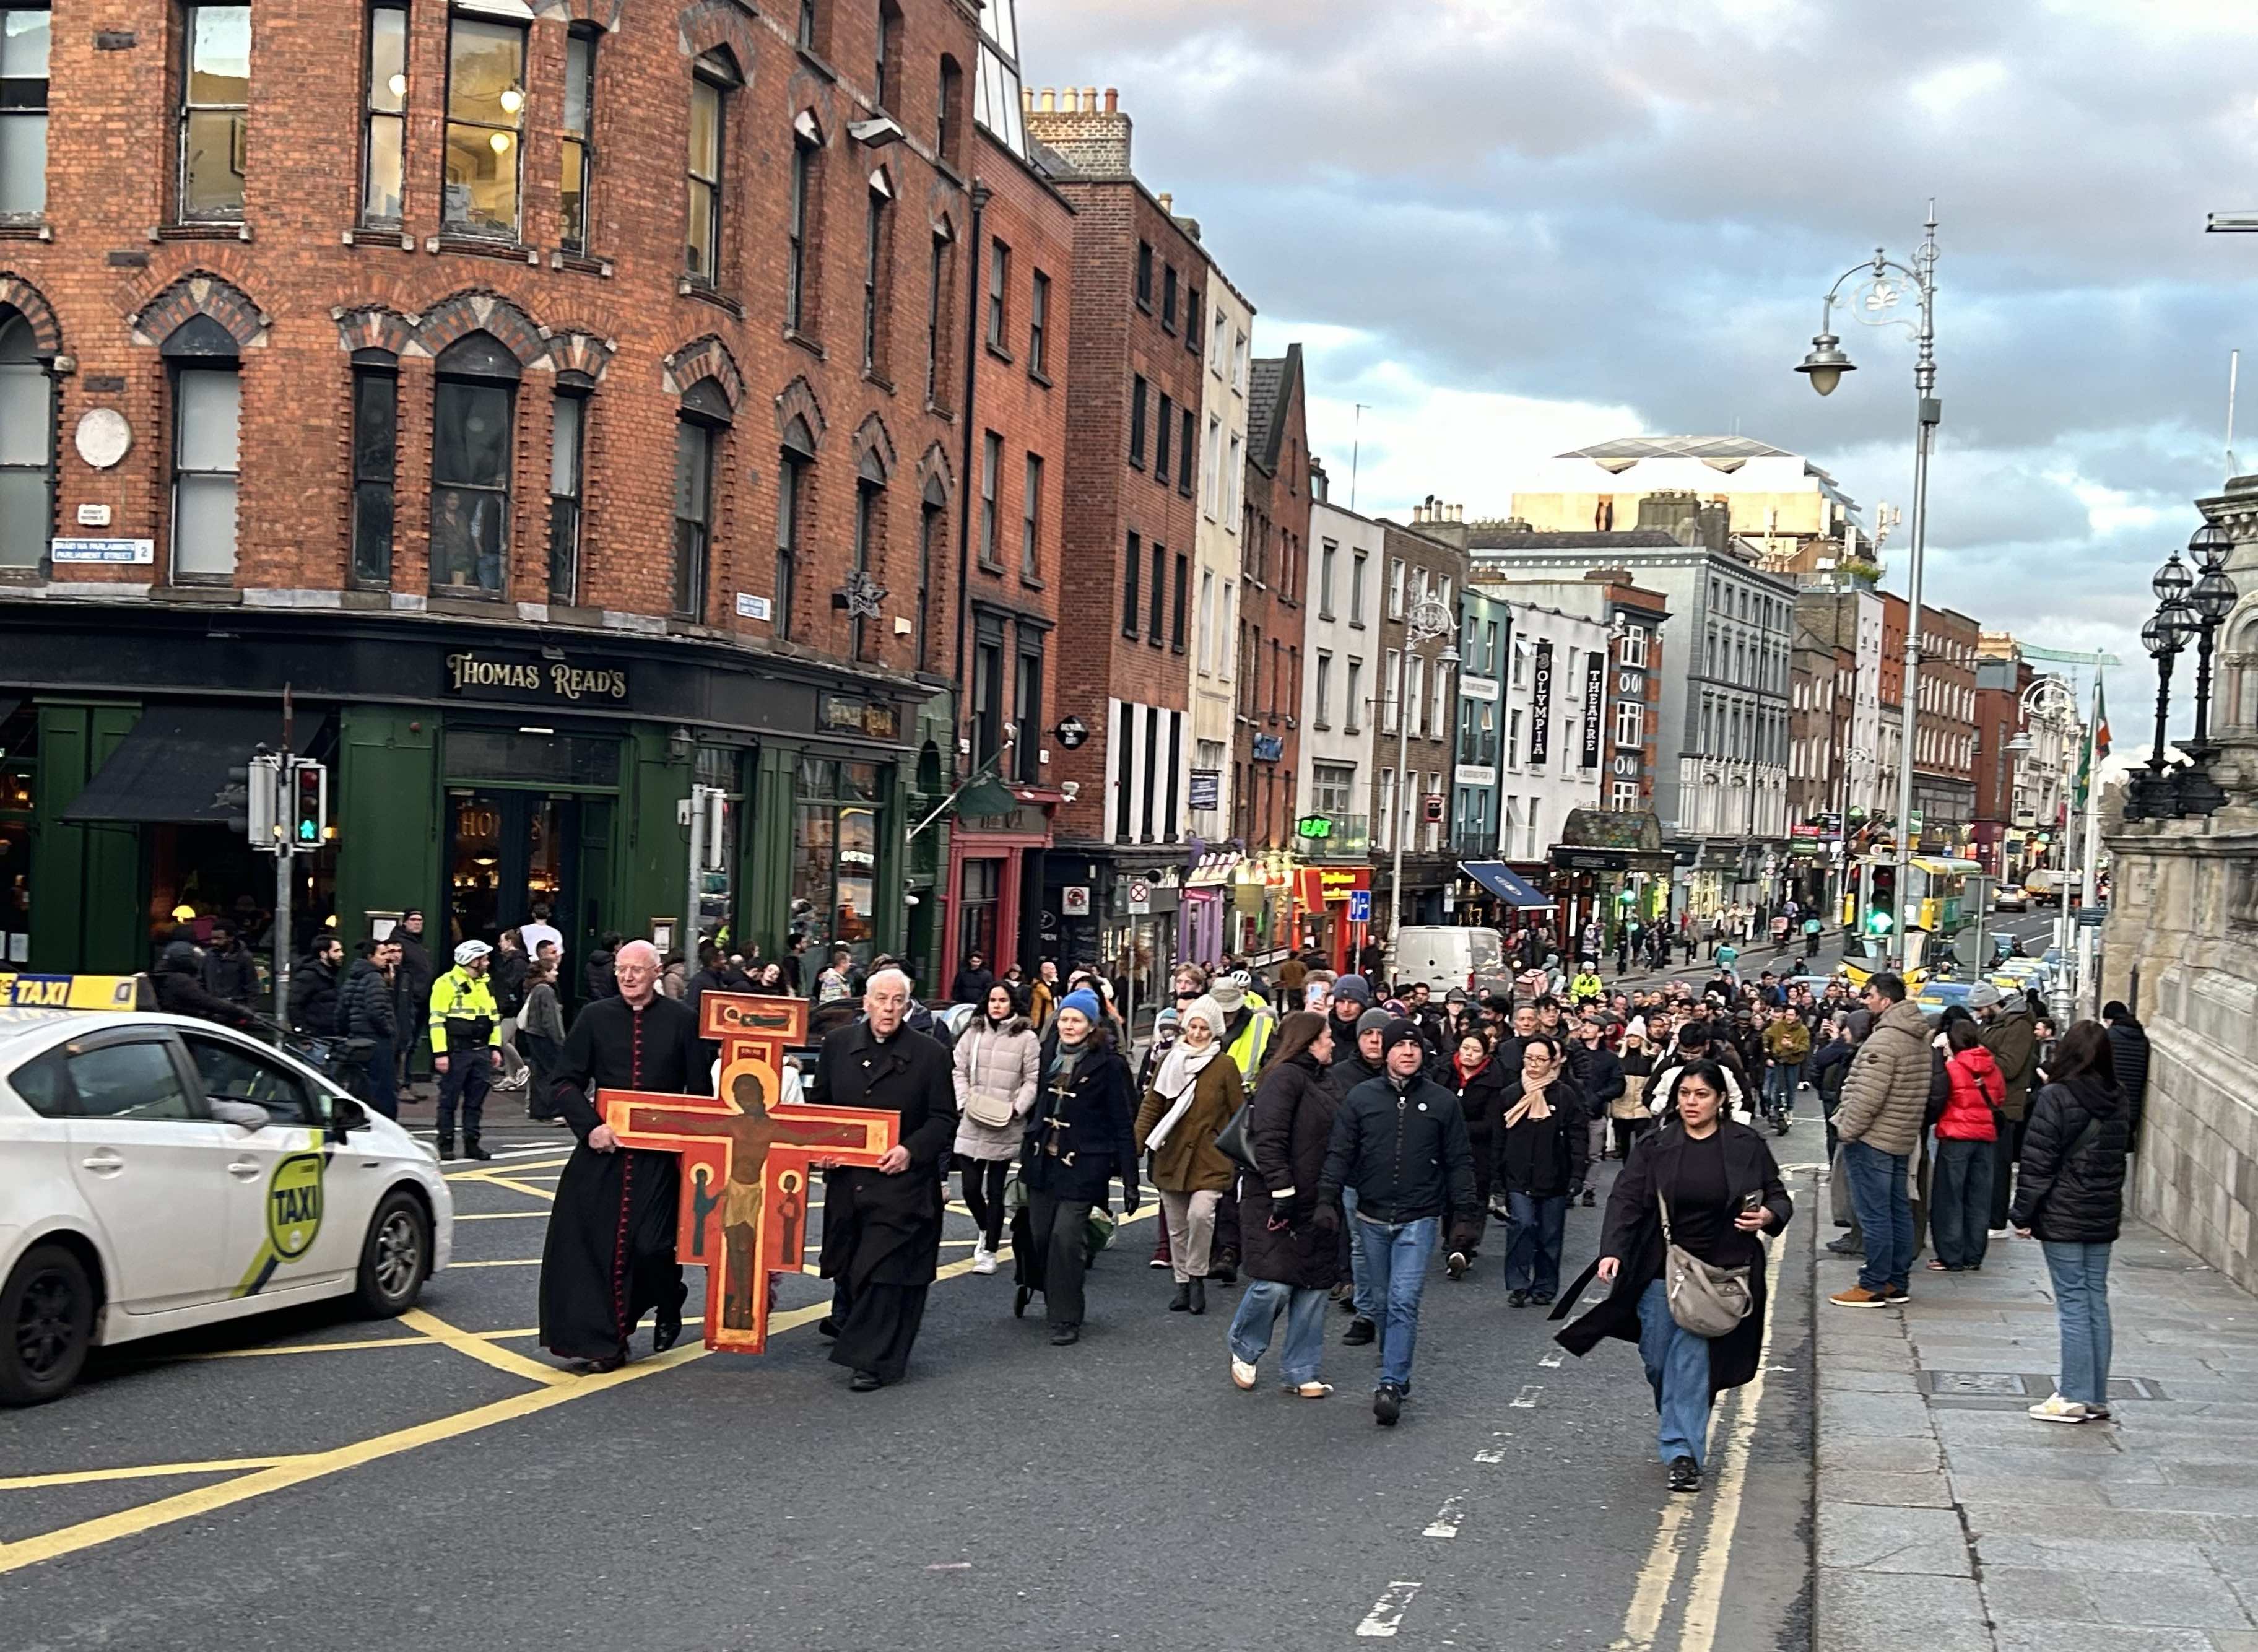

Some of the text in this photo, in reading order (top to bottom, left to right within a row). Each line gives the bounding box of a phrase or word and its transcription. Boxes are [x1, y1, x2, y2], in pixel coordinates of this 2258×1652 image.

[141, 547, 148, 557] 2
[446, 653, 627, 700] THOMAS READ'S
[1533, 670, 1548, 754] OLYMPIA
[1586, 671, 1600, 751] THEATRE
[1301, 819, 1332, 837] EAT
[17, 981, 69, 1005] TAXI
[272, 1185, 318, 1226] TAXI
